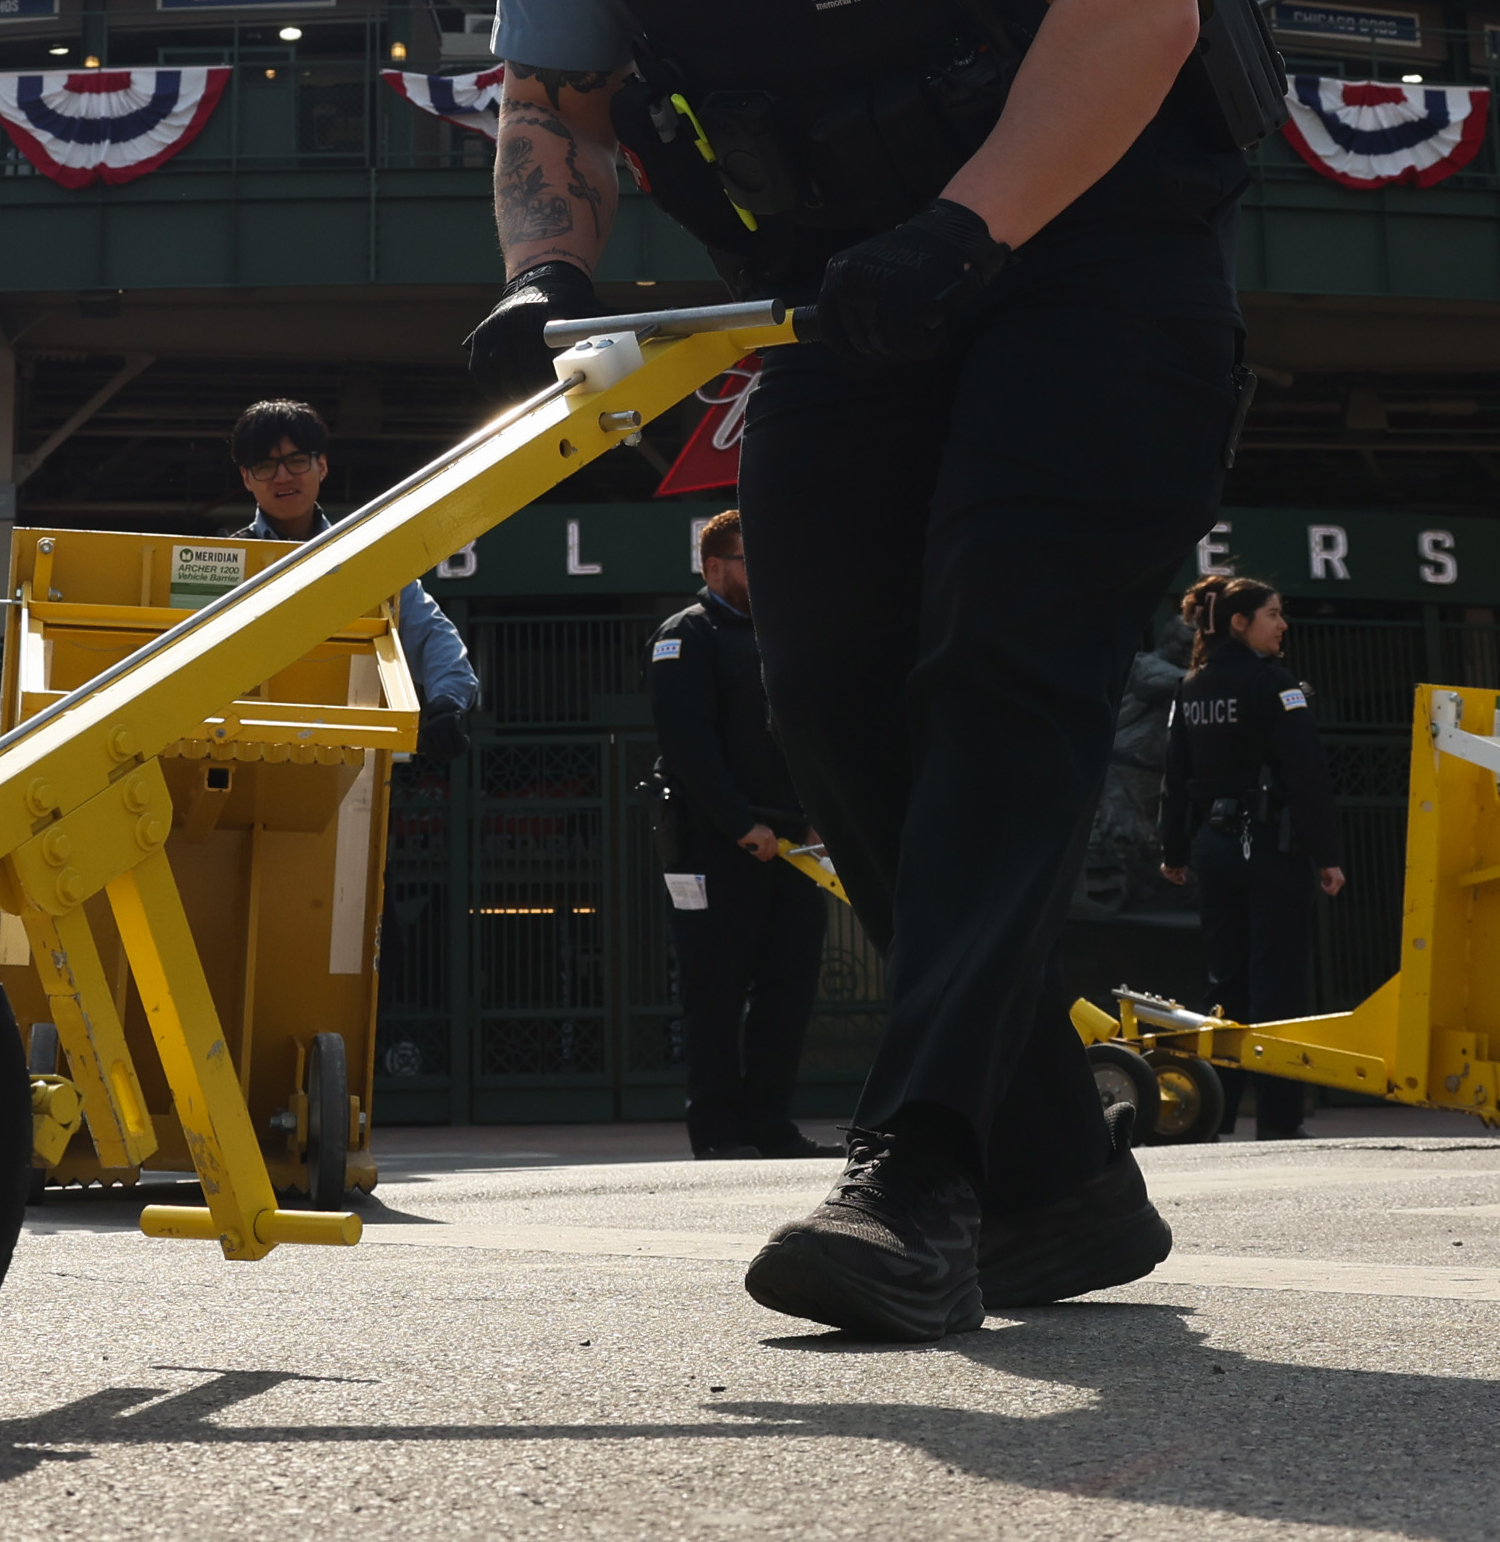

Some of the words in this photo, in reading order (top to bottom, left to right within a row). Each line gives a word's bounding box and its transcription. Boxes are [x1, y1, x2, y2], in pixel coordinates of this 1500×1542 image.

[195, 551, 238, 563] MERIDIAN
[178, 564, 217, 574] ARCHER
[219, 566, 240, 575] 1200
[178, 572, 208, 582] Vehicle
[209, 573, 240, 583] Barrier
[1182, 698, 1238, 726] POLICE
